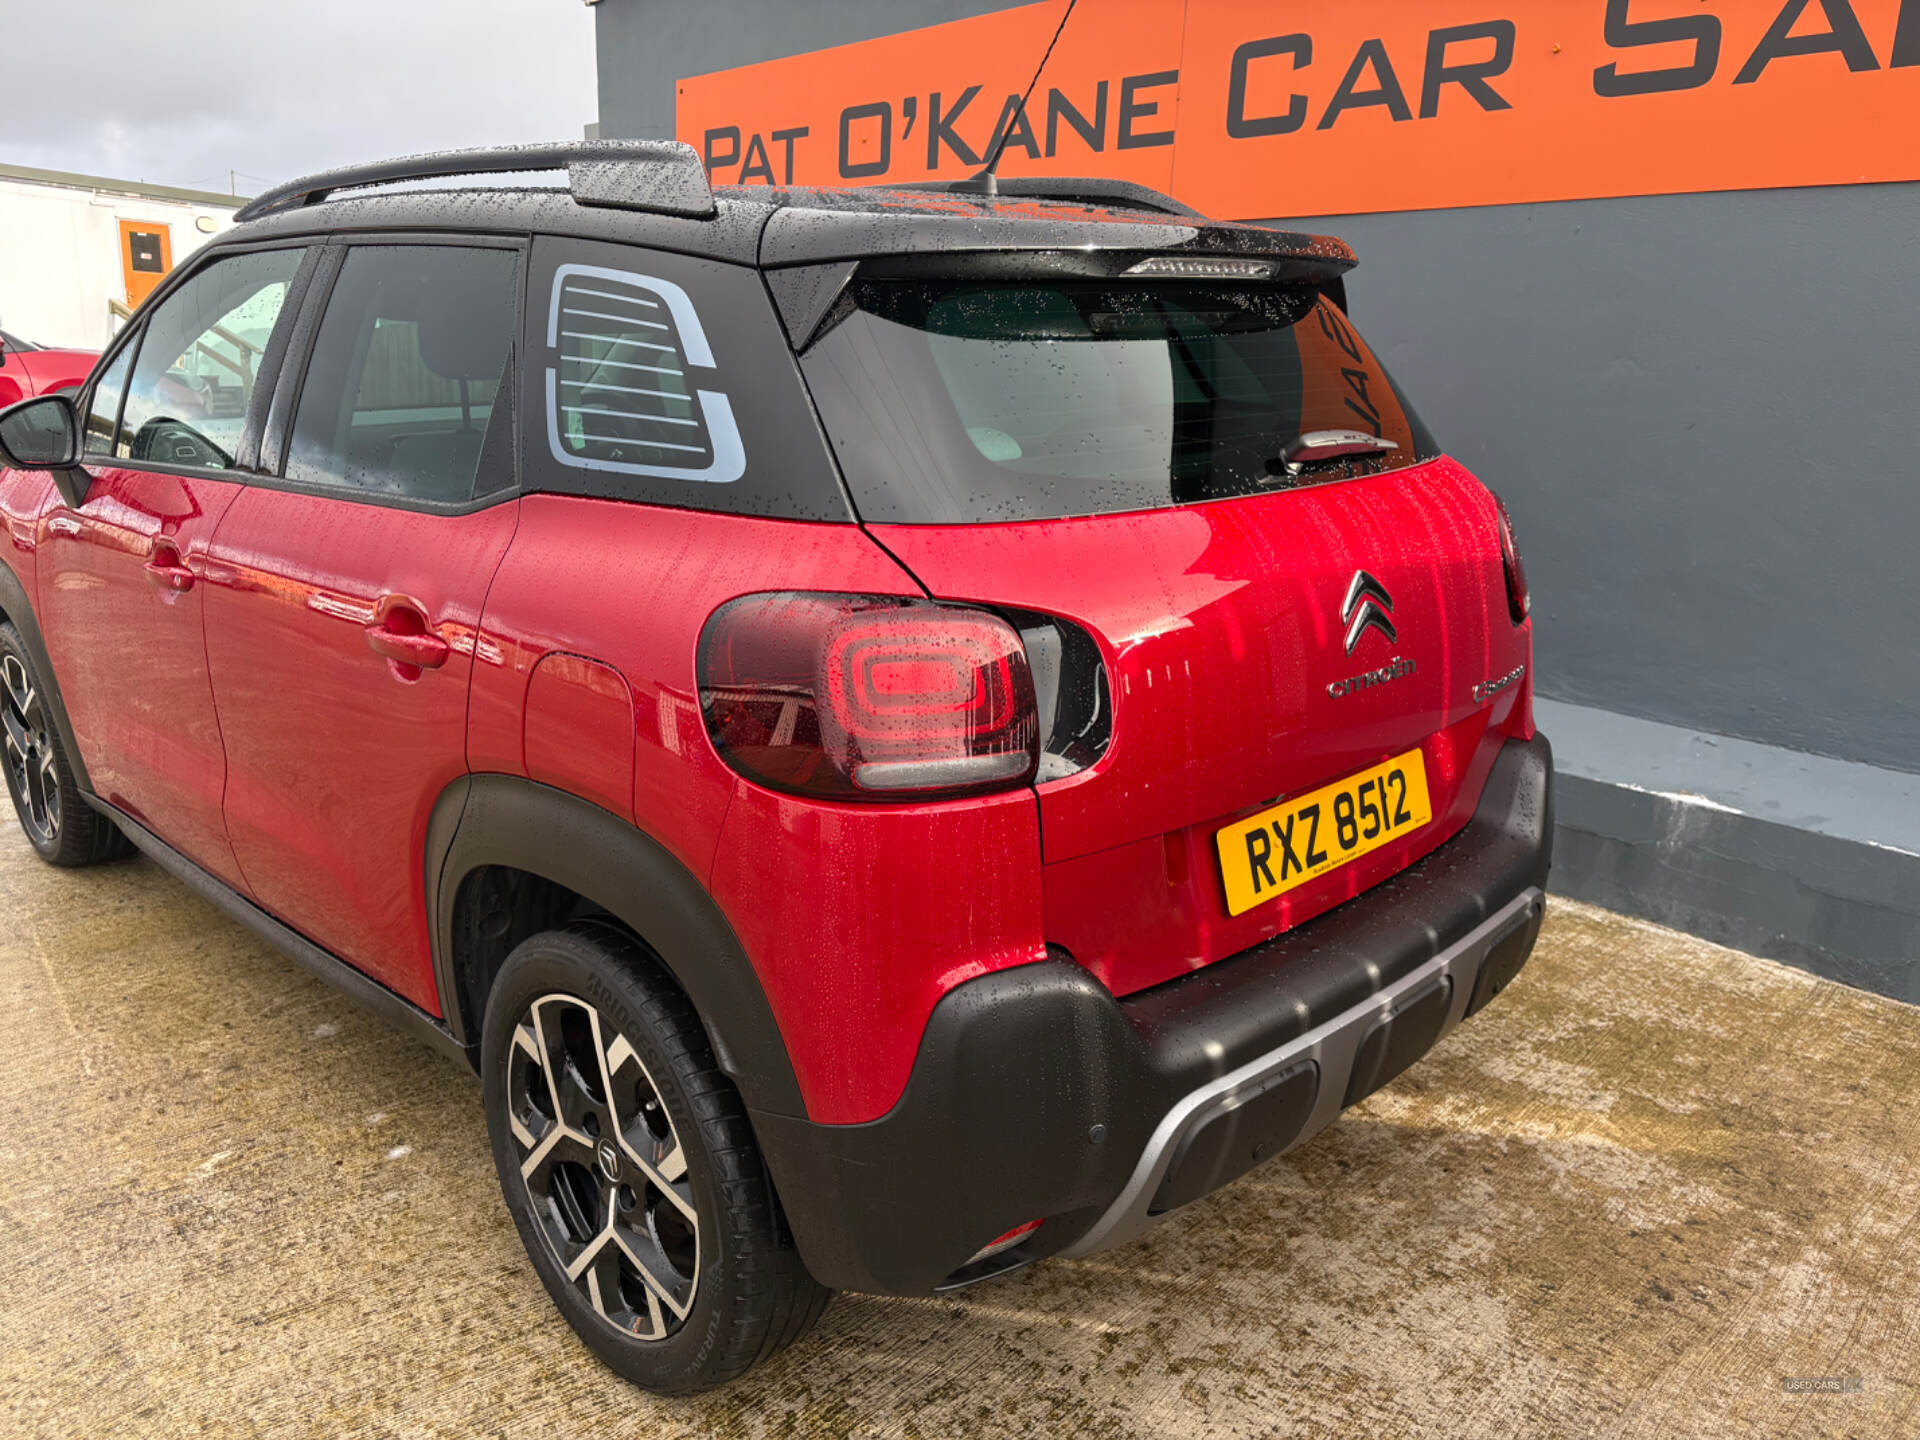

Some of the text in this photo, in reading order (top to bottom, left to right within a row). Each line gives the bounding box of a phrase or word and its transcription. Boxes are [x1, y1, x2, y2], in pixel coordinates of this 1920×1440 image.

[704, 0, 1920, 186] PAT O'KANE CAR SA
[1245, 768, 1411, 894] RXZ 8512
